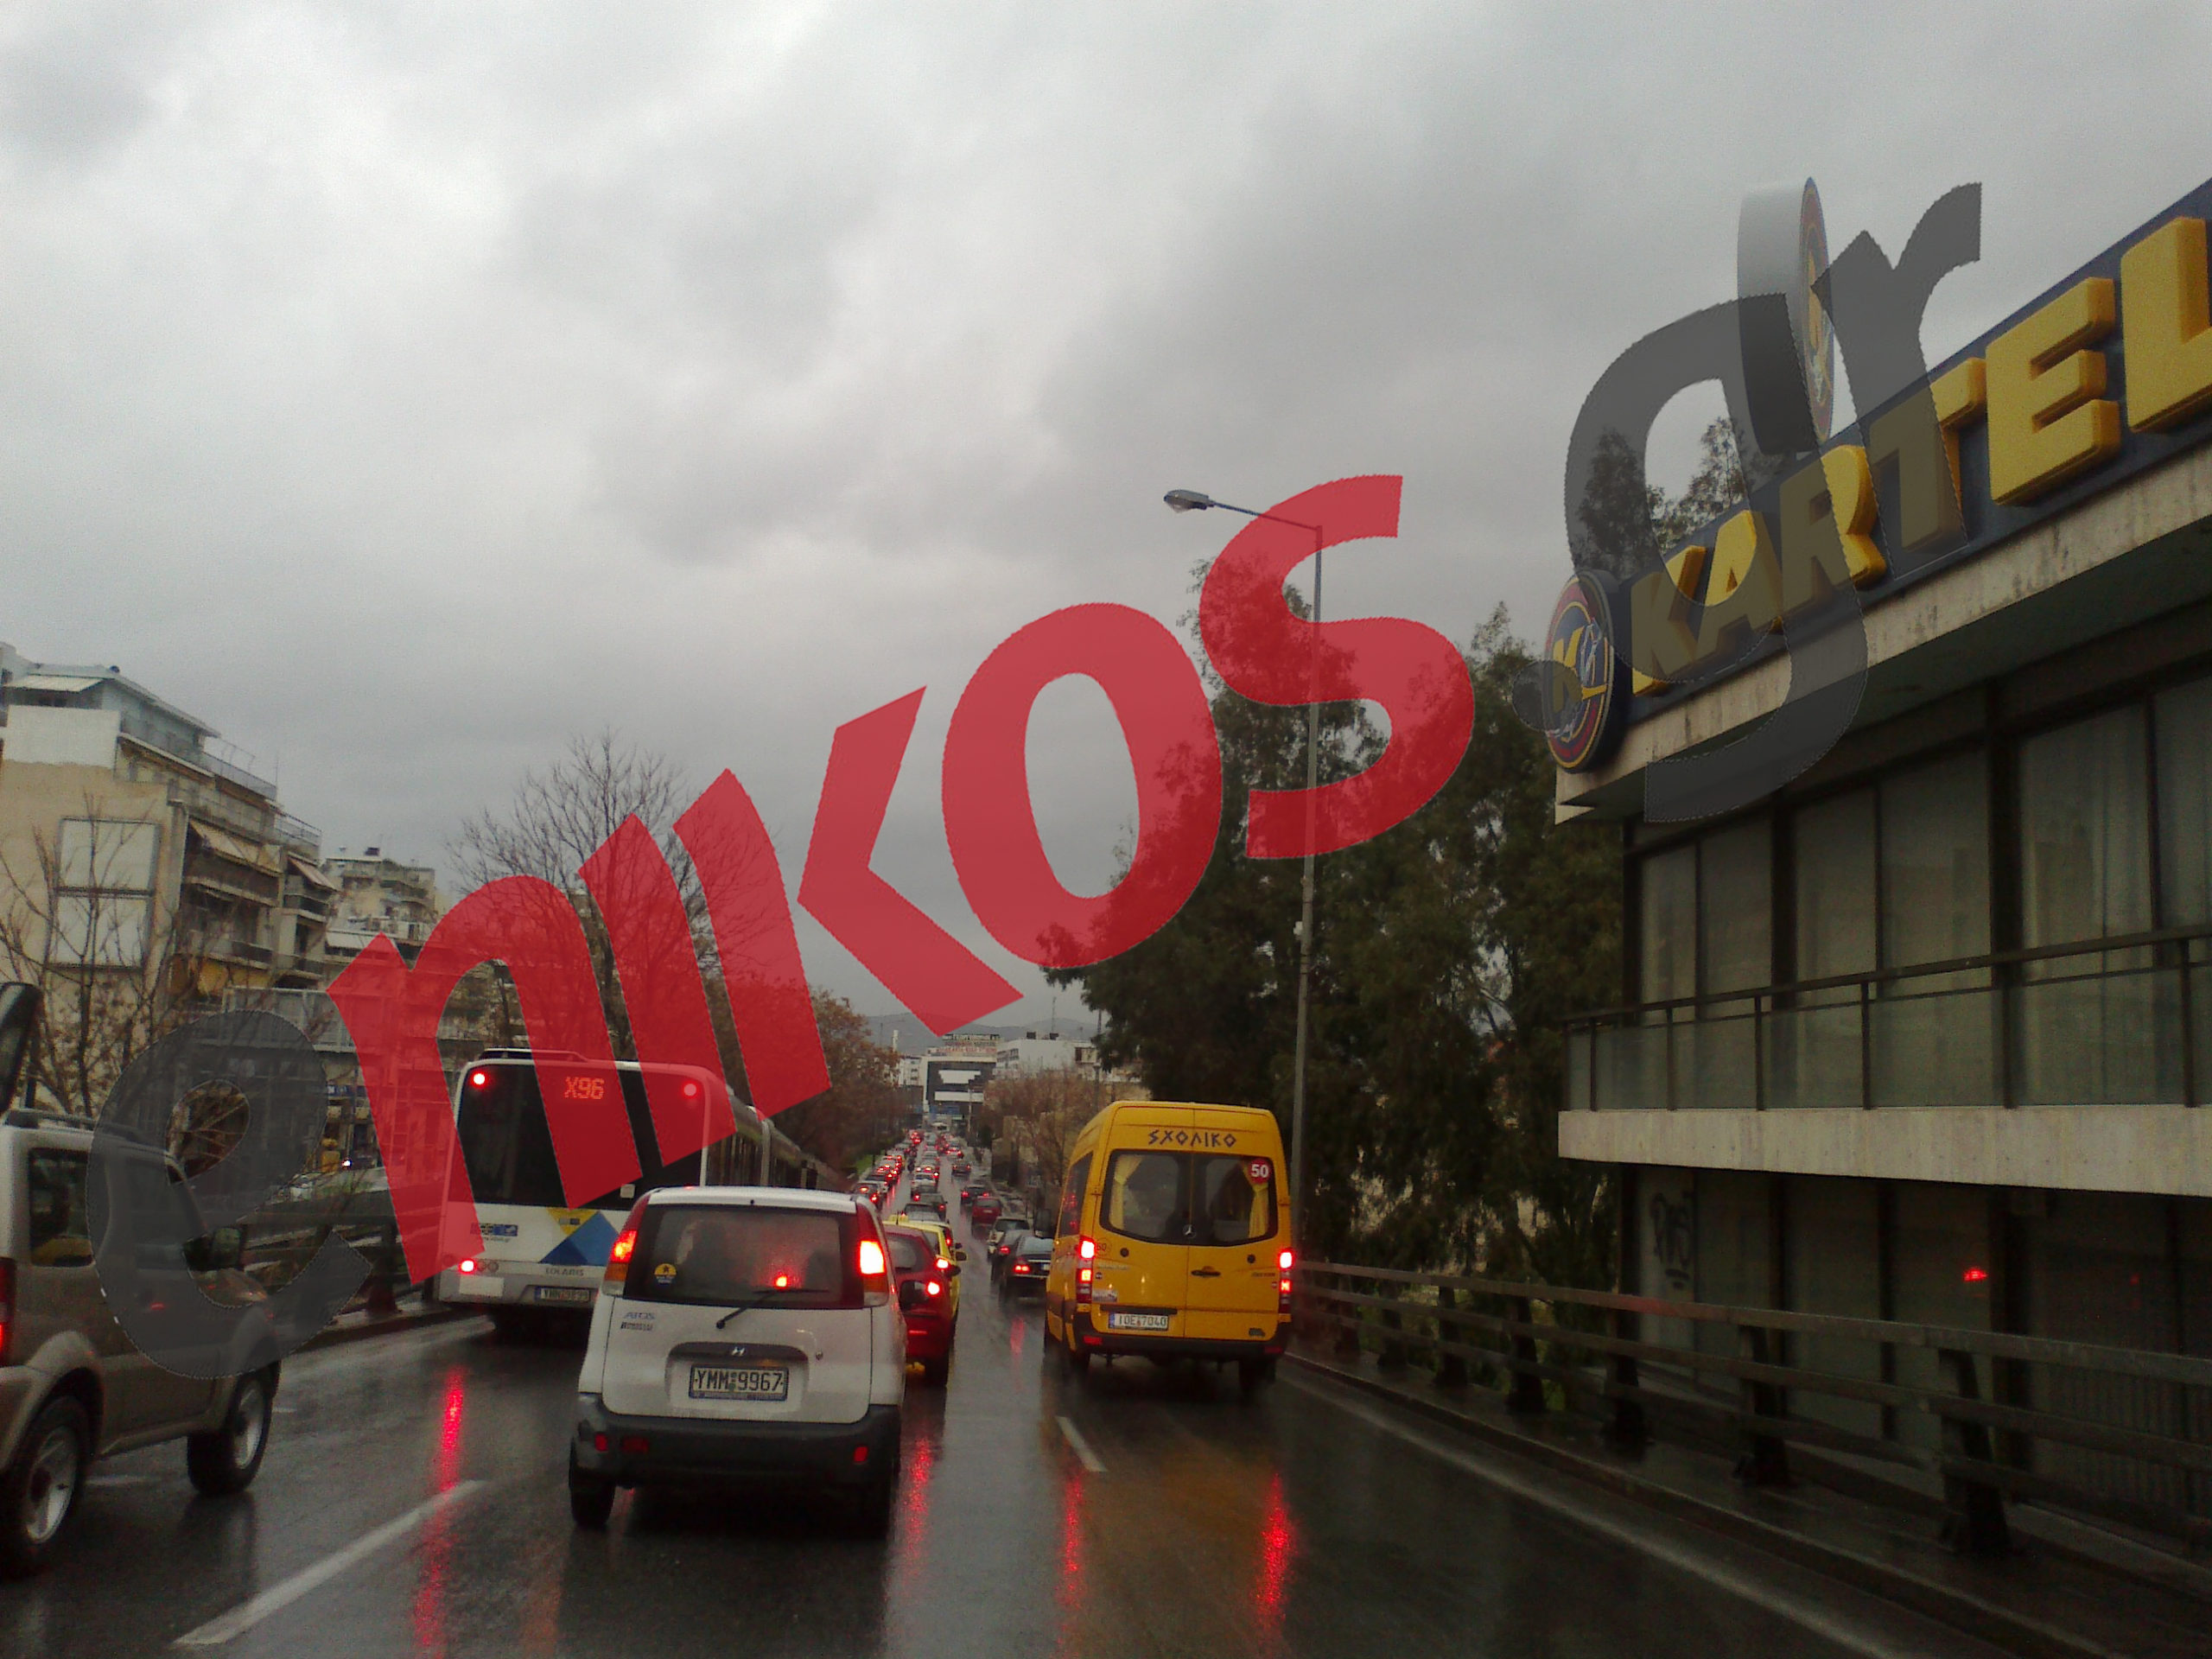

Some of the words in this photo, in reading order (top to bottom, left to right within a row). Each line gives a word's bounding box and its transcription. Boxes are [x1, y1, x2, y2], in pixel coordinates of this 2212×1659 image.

[1630, 215, 2212, 698] KARTEL
[563, 1076, 605, 1100] X96
[1250, 1164, 1269, 1179] 50
[738, 1371, 782, 1391] 9967
